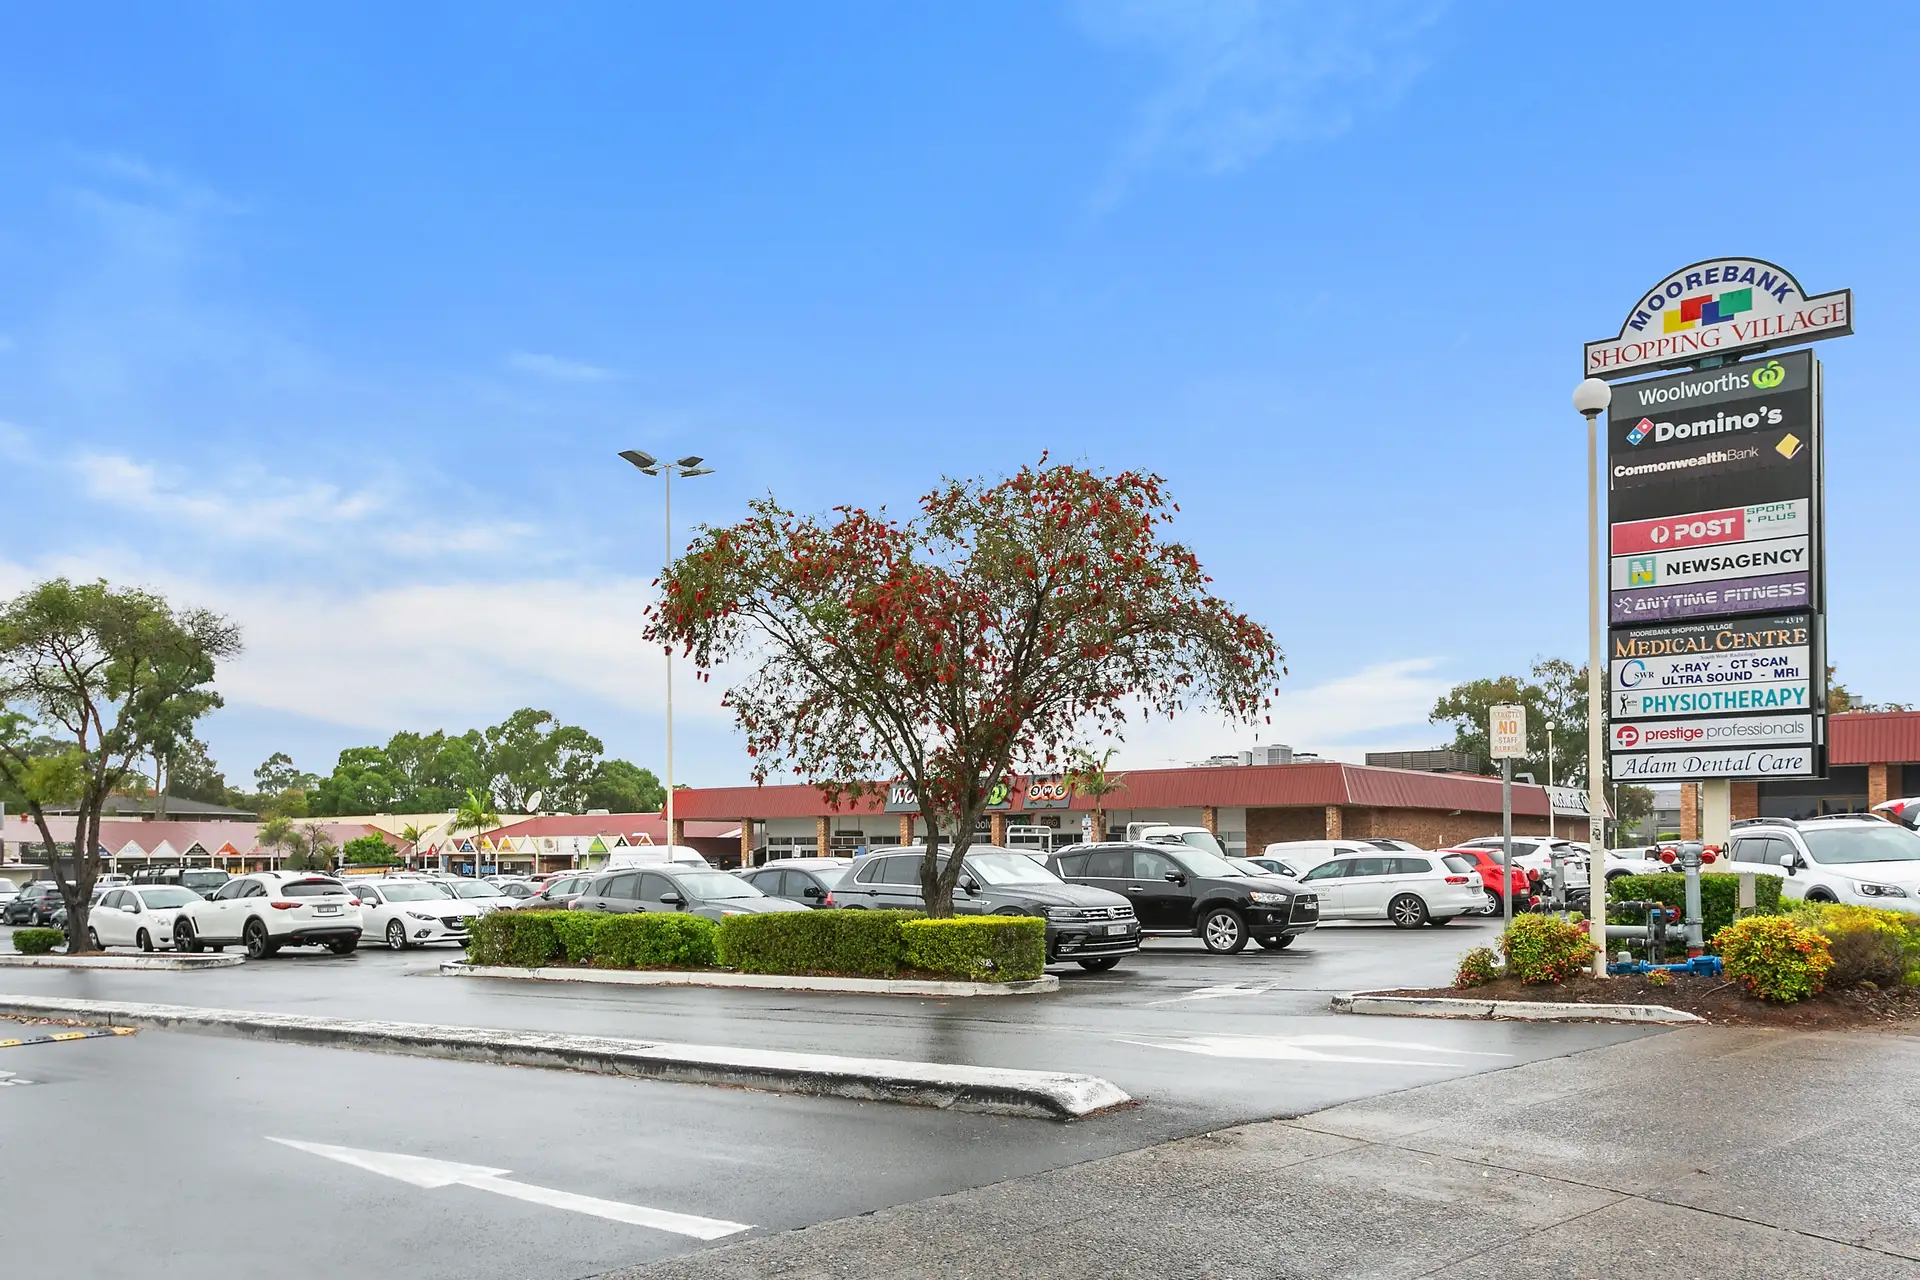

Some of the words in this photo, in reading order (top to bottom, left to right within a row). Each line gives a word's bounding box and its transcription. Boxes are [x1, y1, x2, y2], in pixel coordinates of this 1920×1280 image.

[1629, 266, 1795, 332] MOOREBANK
[1590, 328, 1720, 369] SHOPPING
[1731, 301, 1846, 341] VILLAGE
[1638, 372, 1750, 406] Woolworths
[1655, 406, 1783, 442] Domino's
[1614, 446, 1759, 478] CommonwealthBank
[1746, 502, 1795, 515] SPORT
[1757, 511, 1797, 523] PLUS
[1675, 517, 1736, 541] POST
[1666, 547, 1805, 577] NEWSAGENCY
[1634, 590, 1717, 611] ANYTIME
[1724, 582, 1806, 603] FITNESS
[1615, 635, 1713, 657] MEDICAL
[1715, 627, 1808, 650] CENTRE
[1630, 628, 1670, 638] MOOREBANK
[1671, 625, 1704, 635] SHOPPING
[1706, 622, 1733, 631] VILLAGE
[1634, 671, 1655, 679] SWR
[1662, 674, 1703, 686] ULTRA
[1706, 670, 1753, 682] SOUND
[1774, 667, 1799, 679] MRI
[1671, 661, 1711, 674] X-RAY
[1730, 659, 1748, 669] CT
[1751, 656, 1788, 668] SCAN
[1642, 687, 1806, 713] PHYSIOTHERAPY
[1498, 720, 1518, 735] NO
[1645, 726, 1704, 742] prestige
[1707, 720, 1805, 740] professionals
[1498, 736, 1519, 744] STAFF
[1620, 755, 1677, 777] Adam
[1682, 752, 1756, 773] Dental
[1758, 754, 1803, 771] Care
